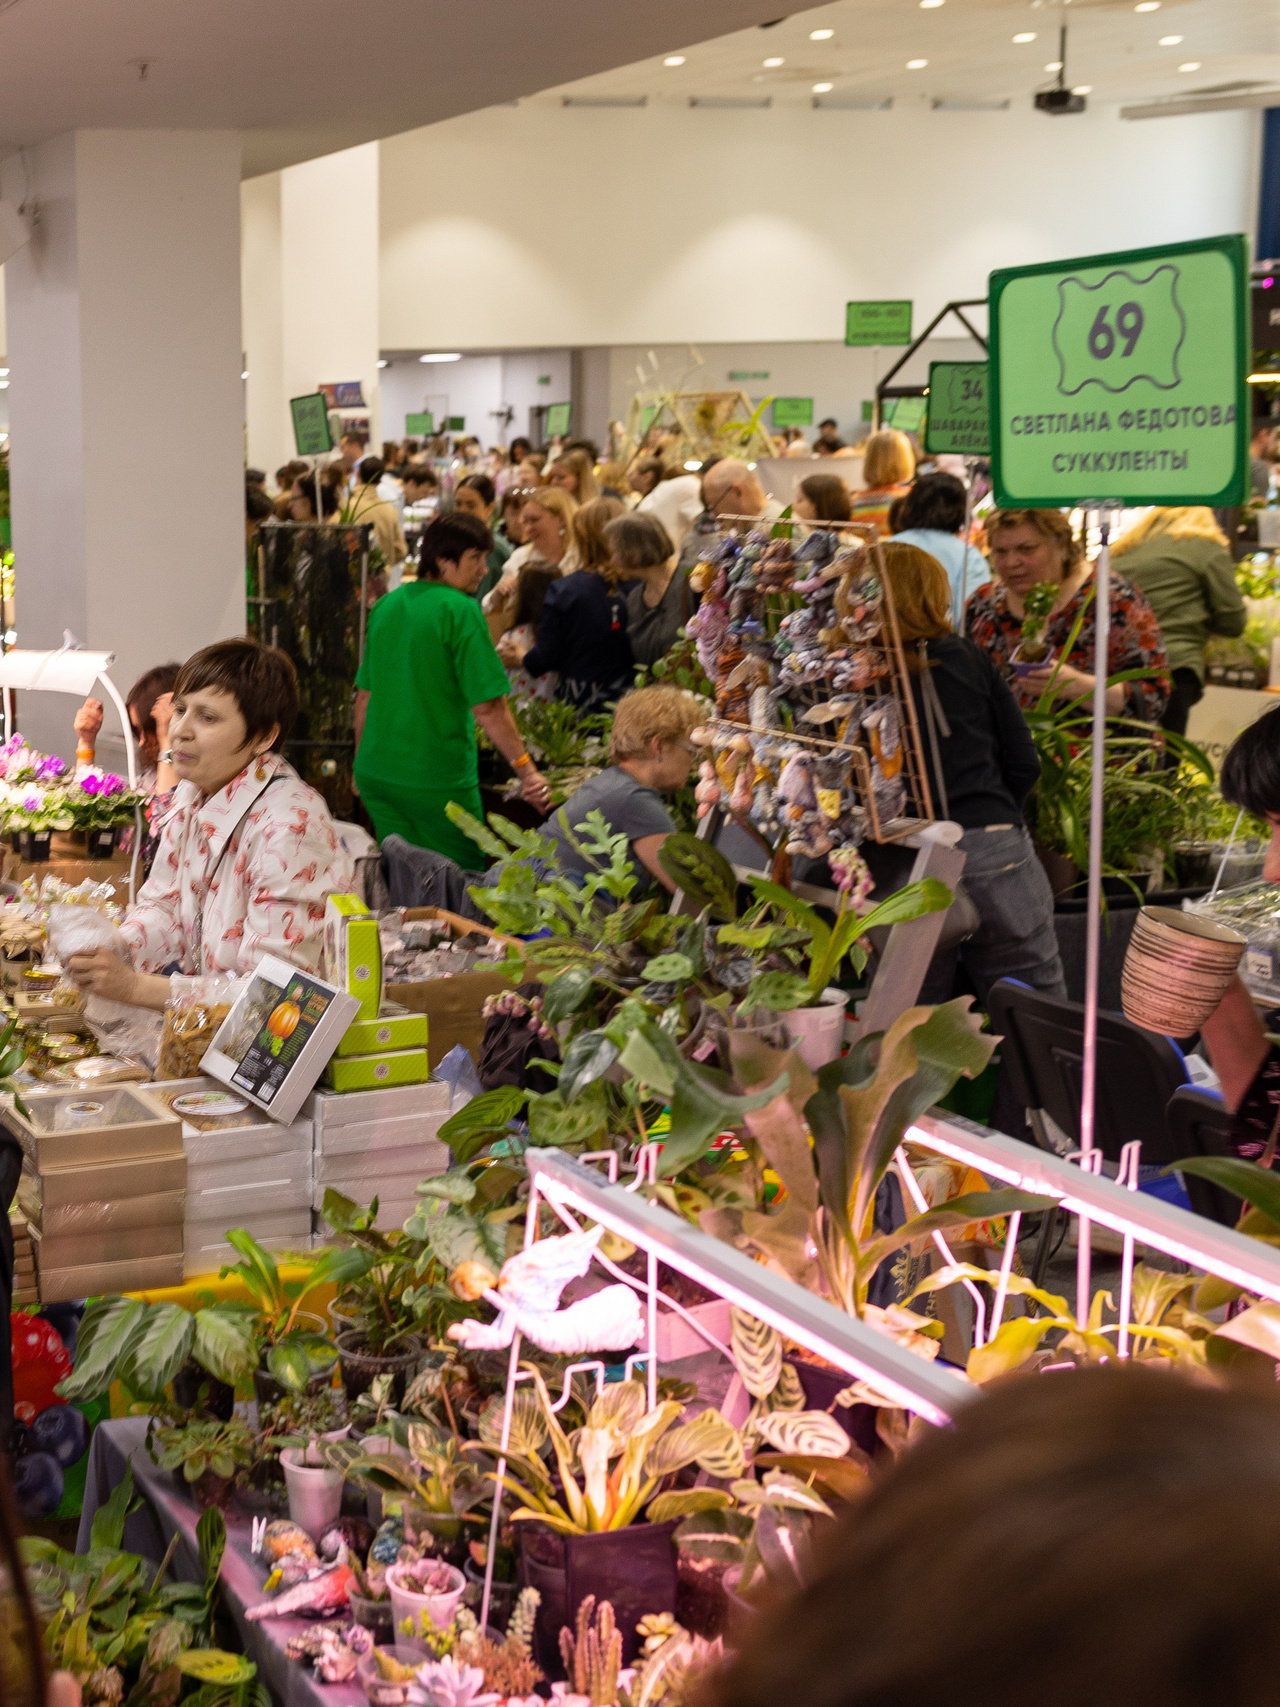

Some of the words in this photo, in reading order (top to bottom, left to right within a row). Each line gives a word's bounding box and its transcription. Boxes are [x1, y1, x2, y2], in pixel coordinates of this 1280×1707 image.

[1088, 301, 1144, 360] 69
[1010, 410, 1112, 436] СВЕТЛАНА
[1117, 403, 1236, 432] ФЕДОТОВА
[1052, 449, 1188, 474] СУККУЛЕНТЫ
